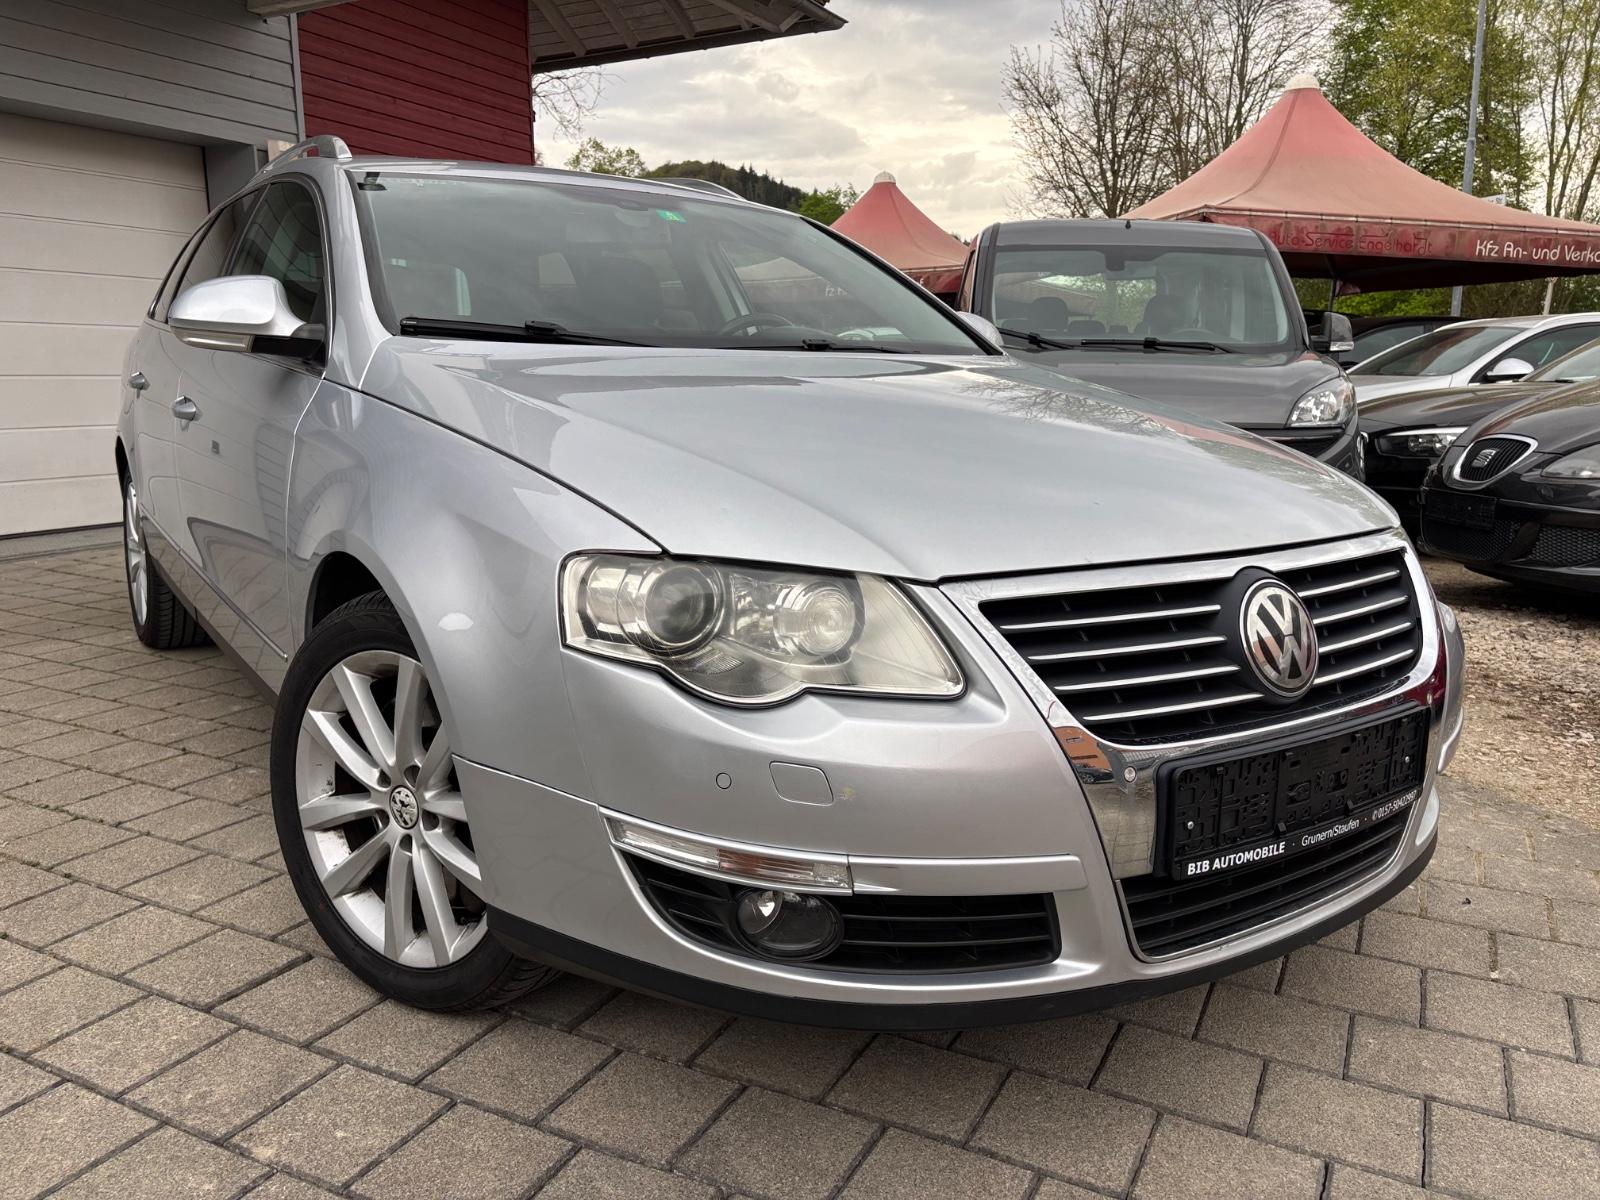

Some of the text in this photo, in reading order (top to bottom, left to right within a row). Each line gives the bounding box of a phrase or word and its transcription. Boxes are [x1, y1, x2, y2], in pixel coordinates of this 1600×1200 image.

[1475, 239, 1500, 257] Kfz
[1503, 241, 1528, 259] An-
[1532, 245, 1561, 261] und
[1187, 853, 1210, 876] BIB
[1212, 841, 1286, 871] AUTOMOBILE
[1301, 819, 1360, 847] Grunern/Staufen
